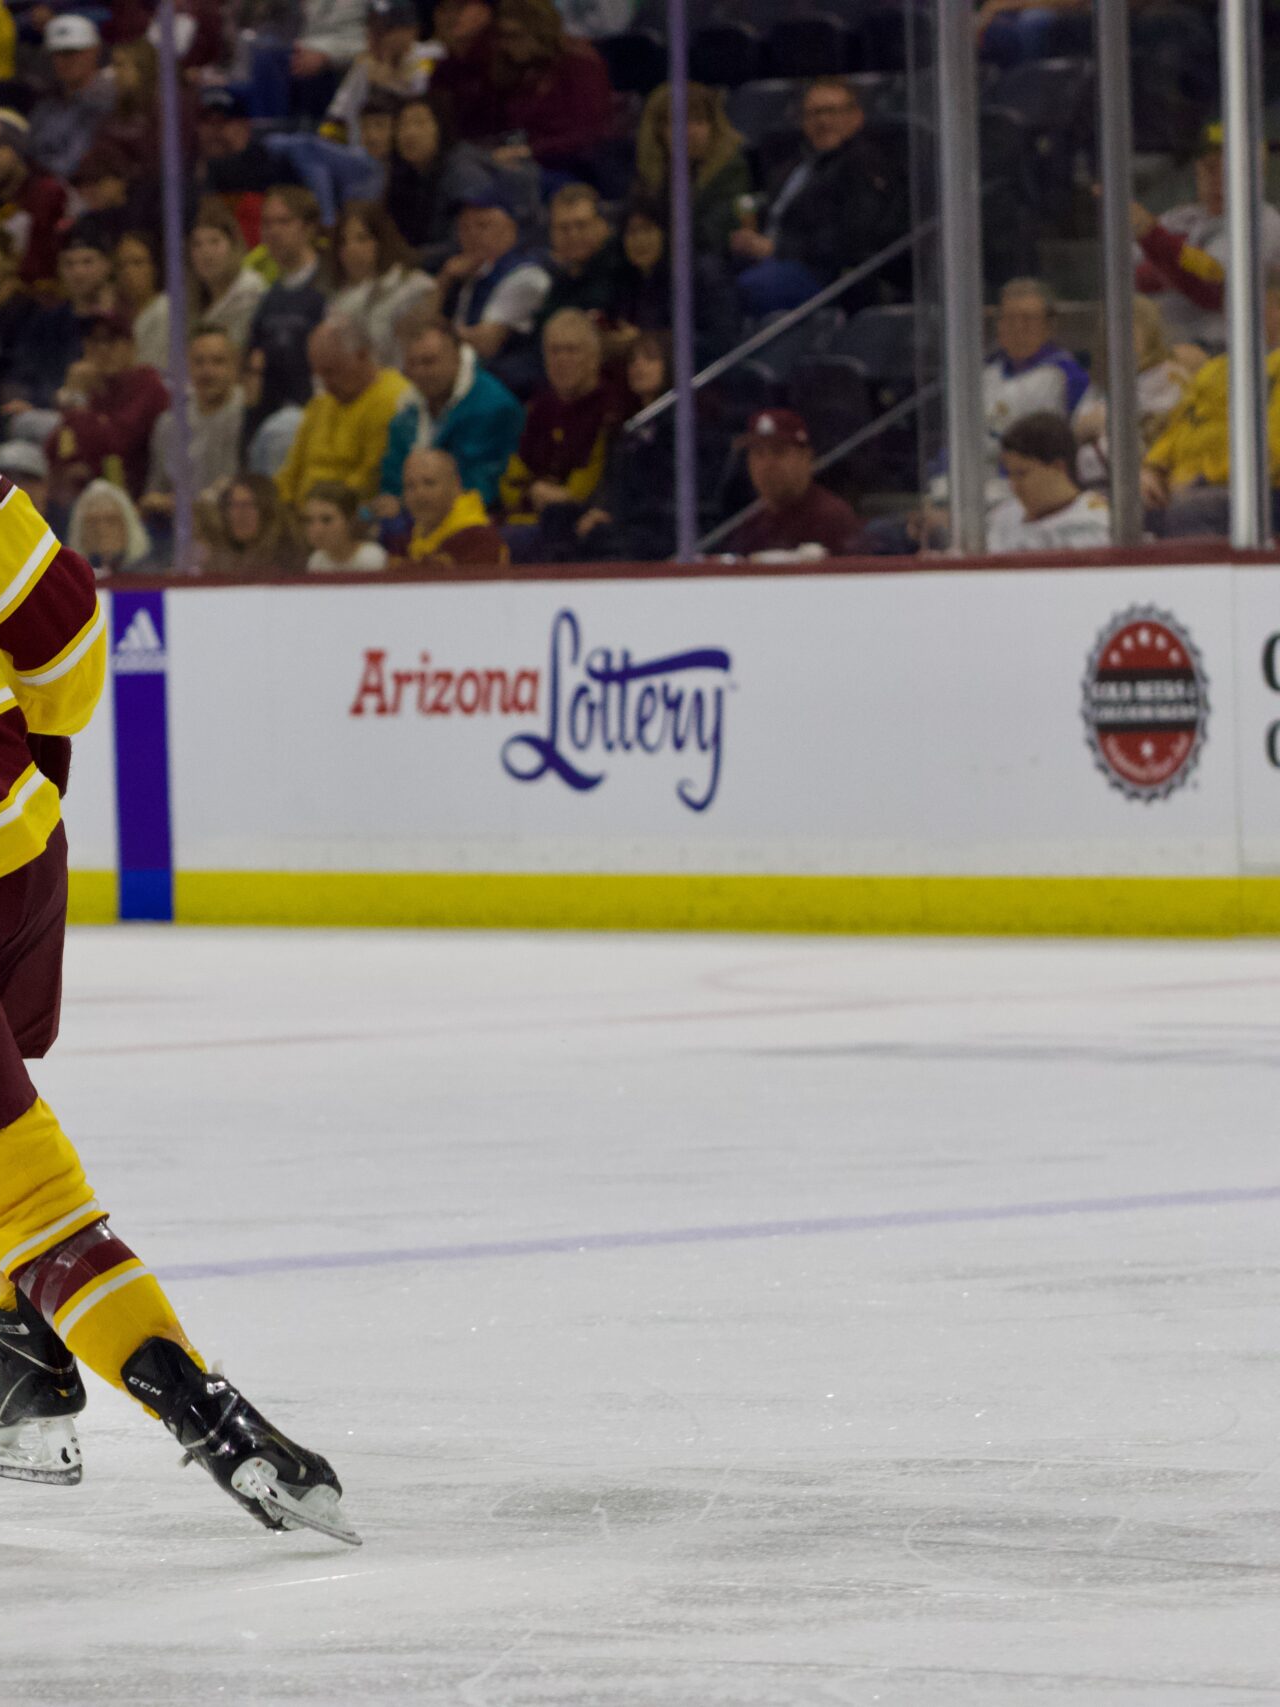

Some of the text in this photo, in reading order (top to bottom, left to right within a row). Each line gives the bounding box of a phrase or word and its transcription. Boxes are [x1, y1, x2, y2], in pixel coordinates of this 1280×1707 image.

[349, 606, 731, 813] Arizona Lottery
[128, 1375, 163, 1397] CCM
